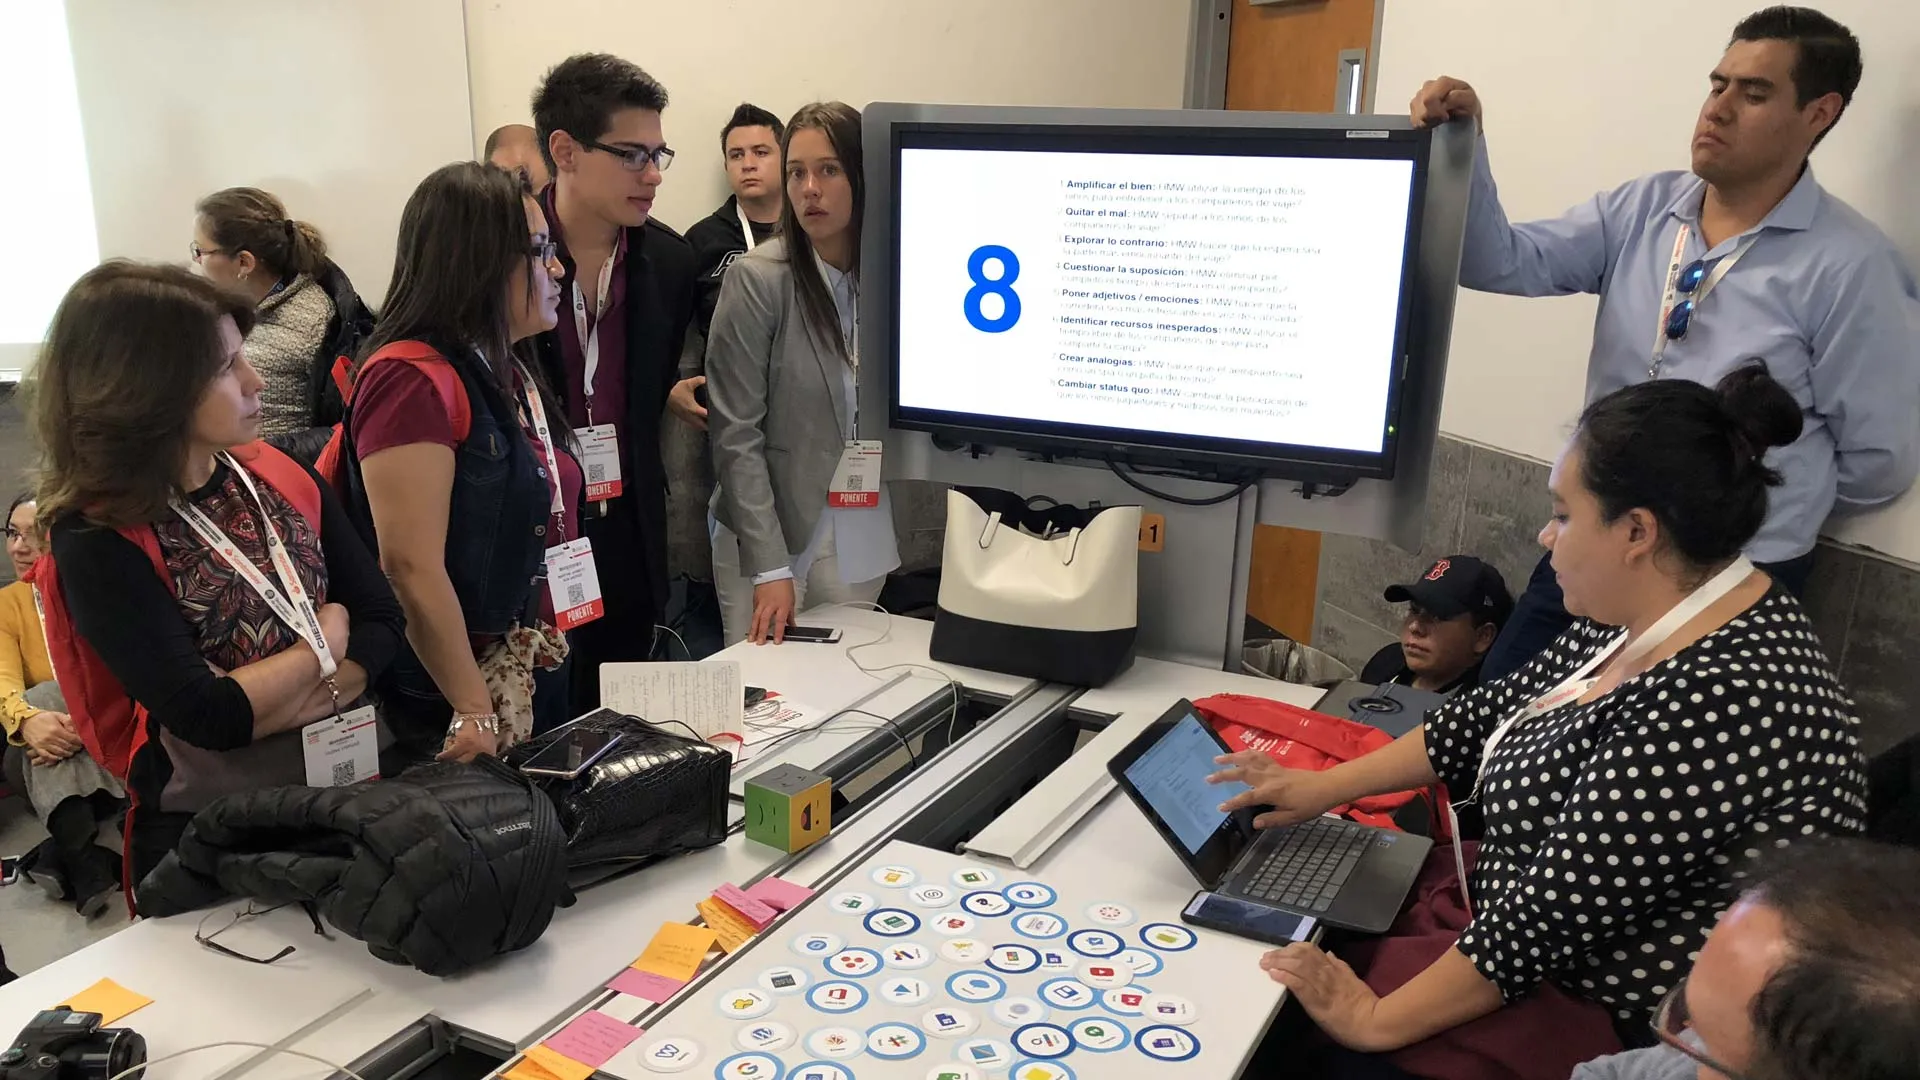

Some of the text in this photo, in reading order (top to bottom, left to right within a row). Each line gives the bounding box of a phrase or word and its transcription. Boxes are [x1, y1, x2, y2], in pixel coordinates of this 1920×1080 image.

[1067, 180, 1116, 190] Amplificar
[1131, 182, 1156, 190] bien:
[1066, 208, 1095, 216] Quitar
[1065, 235, 1104, 245] Explorar
[1108, 237, 1116, 245] lo
[1120, 239, 1167, 247] contrario:
[1063, 263, 1115, 272] Cuestionar
[1118, 265, 1126, 273] la
[964, 245, 1021, 333] 8
[1062, 289, 1090, 297] Poner
[1093, 292, 1136, 301] adjetivos
[1139, 293, 1143, 301] /
[1144, 296, 1203, 304] emociones:
[1061, 316, 1108, 325] Identificar
[1111, 321, 1153, 329] recursos
[1156, 324, 1221, 333] inesperados:
[1059, 353, 1084, 362] Crear
[1057, 379, 1096, 389] Cambiar
[1100, 384, 1128, 392] status
[587, 483, 612, 497] ONENTE
[840, 493, 868, 503] PONENTE
[1149, 523, 1158, 543] 1
[1424, 559, 1451, 581] B
[567, 603, 594, 623] PONENTE
[310, 625, 325, 649] CIIE
